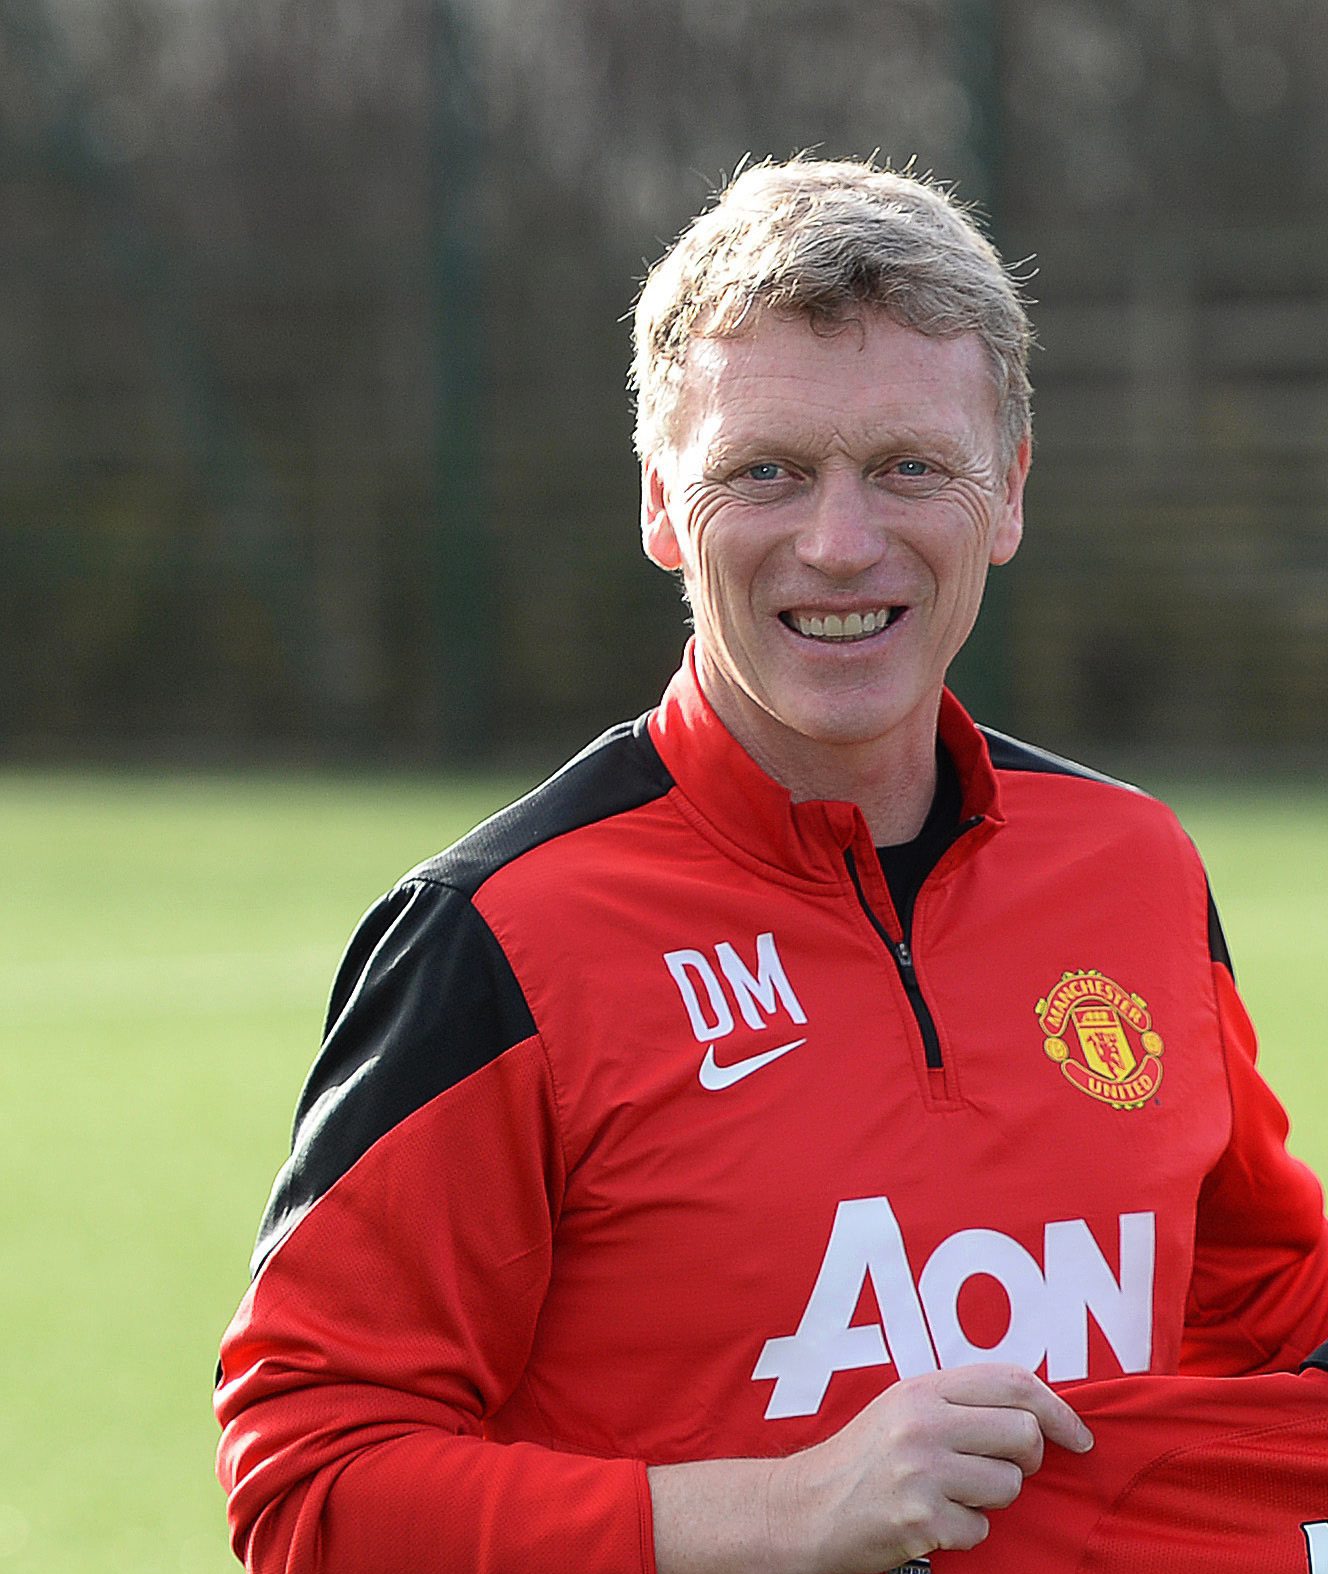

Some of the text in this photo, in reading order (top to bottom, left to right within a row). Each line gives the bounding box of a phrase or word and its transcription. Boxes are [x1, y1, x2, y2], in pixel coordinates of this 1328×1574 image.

[663, 932, 808, 1042] DM
[1047, 979, 1143, 1028] MANCHESTER
[1088, 1074, 1153, 1100] UNITED
[751, 1196, 1155, 1419] AON
